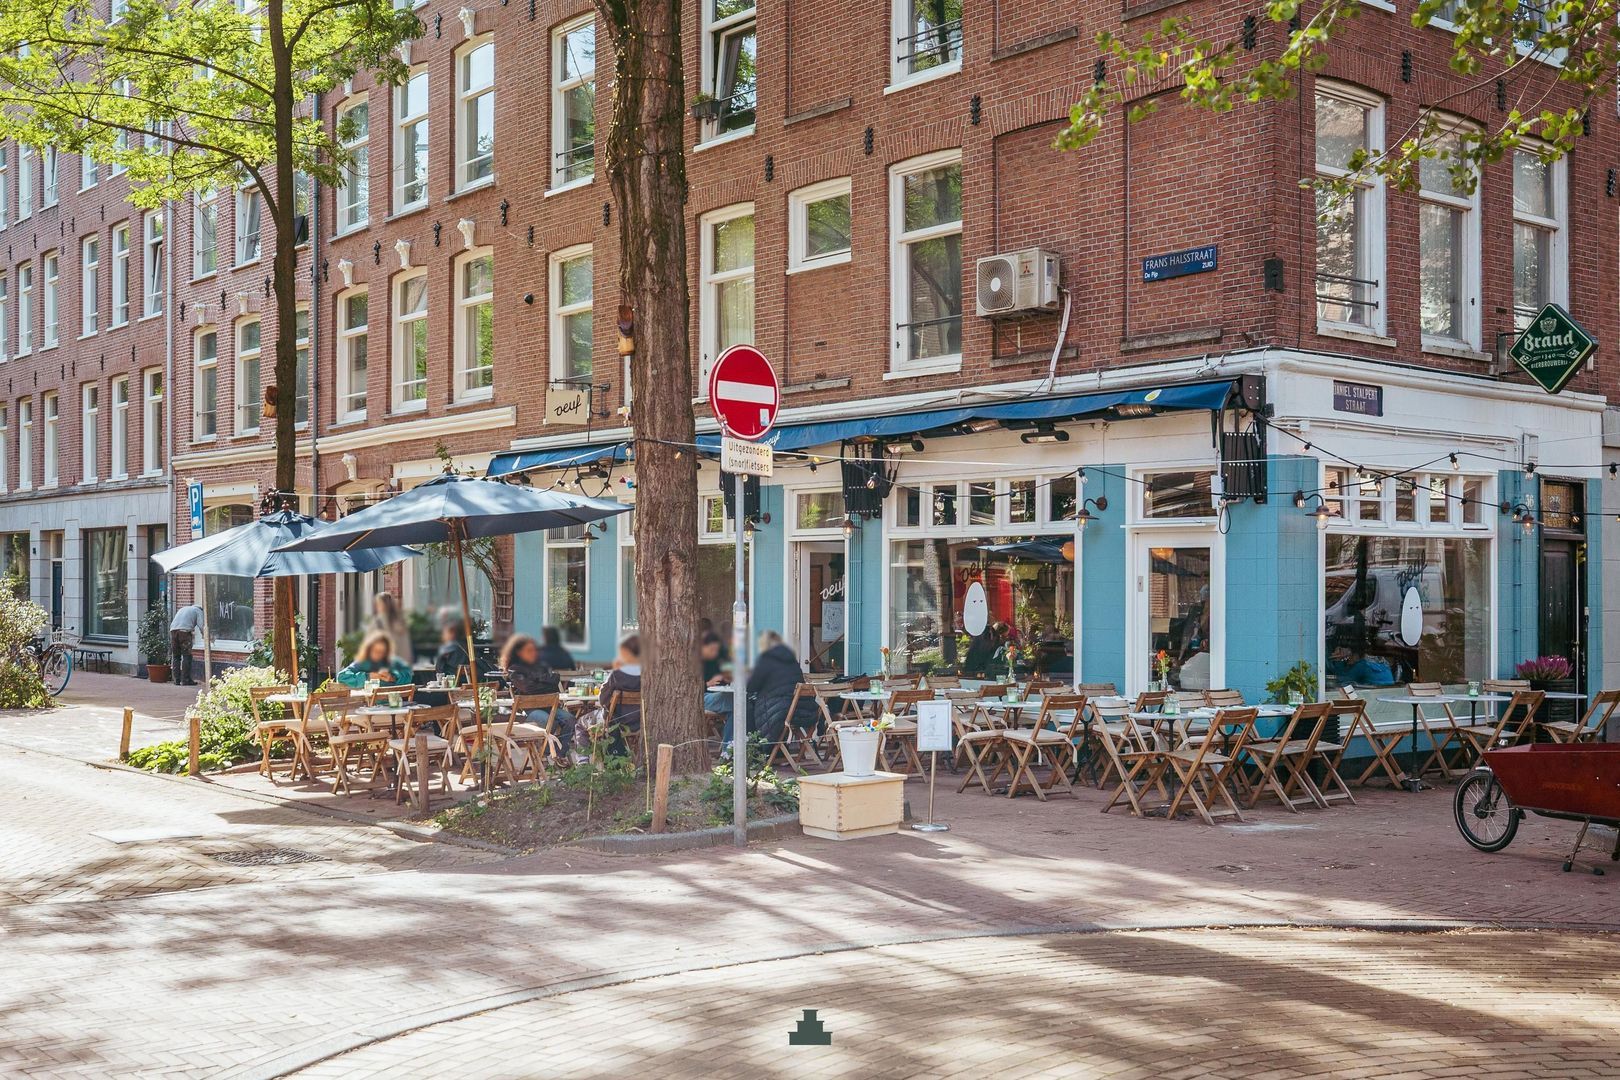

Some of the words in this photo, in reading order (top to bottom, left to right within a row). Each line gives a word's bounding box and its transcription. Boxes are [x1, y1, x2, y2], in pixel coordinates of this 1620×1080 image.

[1145, 257, 1168, 271] FRANS
[1169, 248, 1214, 266] HALSSTRAAT
[1201, 261, 1214, 269] ZUID
[1524, 330, 1575, 352] Brand
[553, 394, 582, 417] oeuf
[1345, 399, 1366, 412] STRAAT
[728, 441, 770, 457] Uitgezonderd
[728, 457, 770, 472] (snor)fietsers
[191, 487, 199, 511] P
